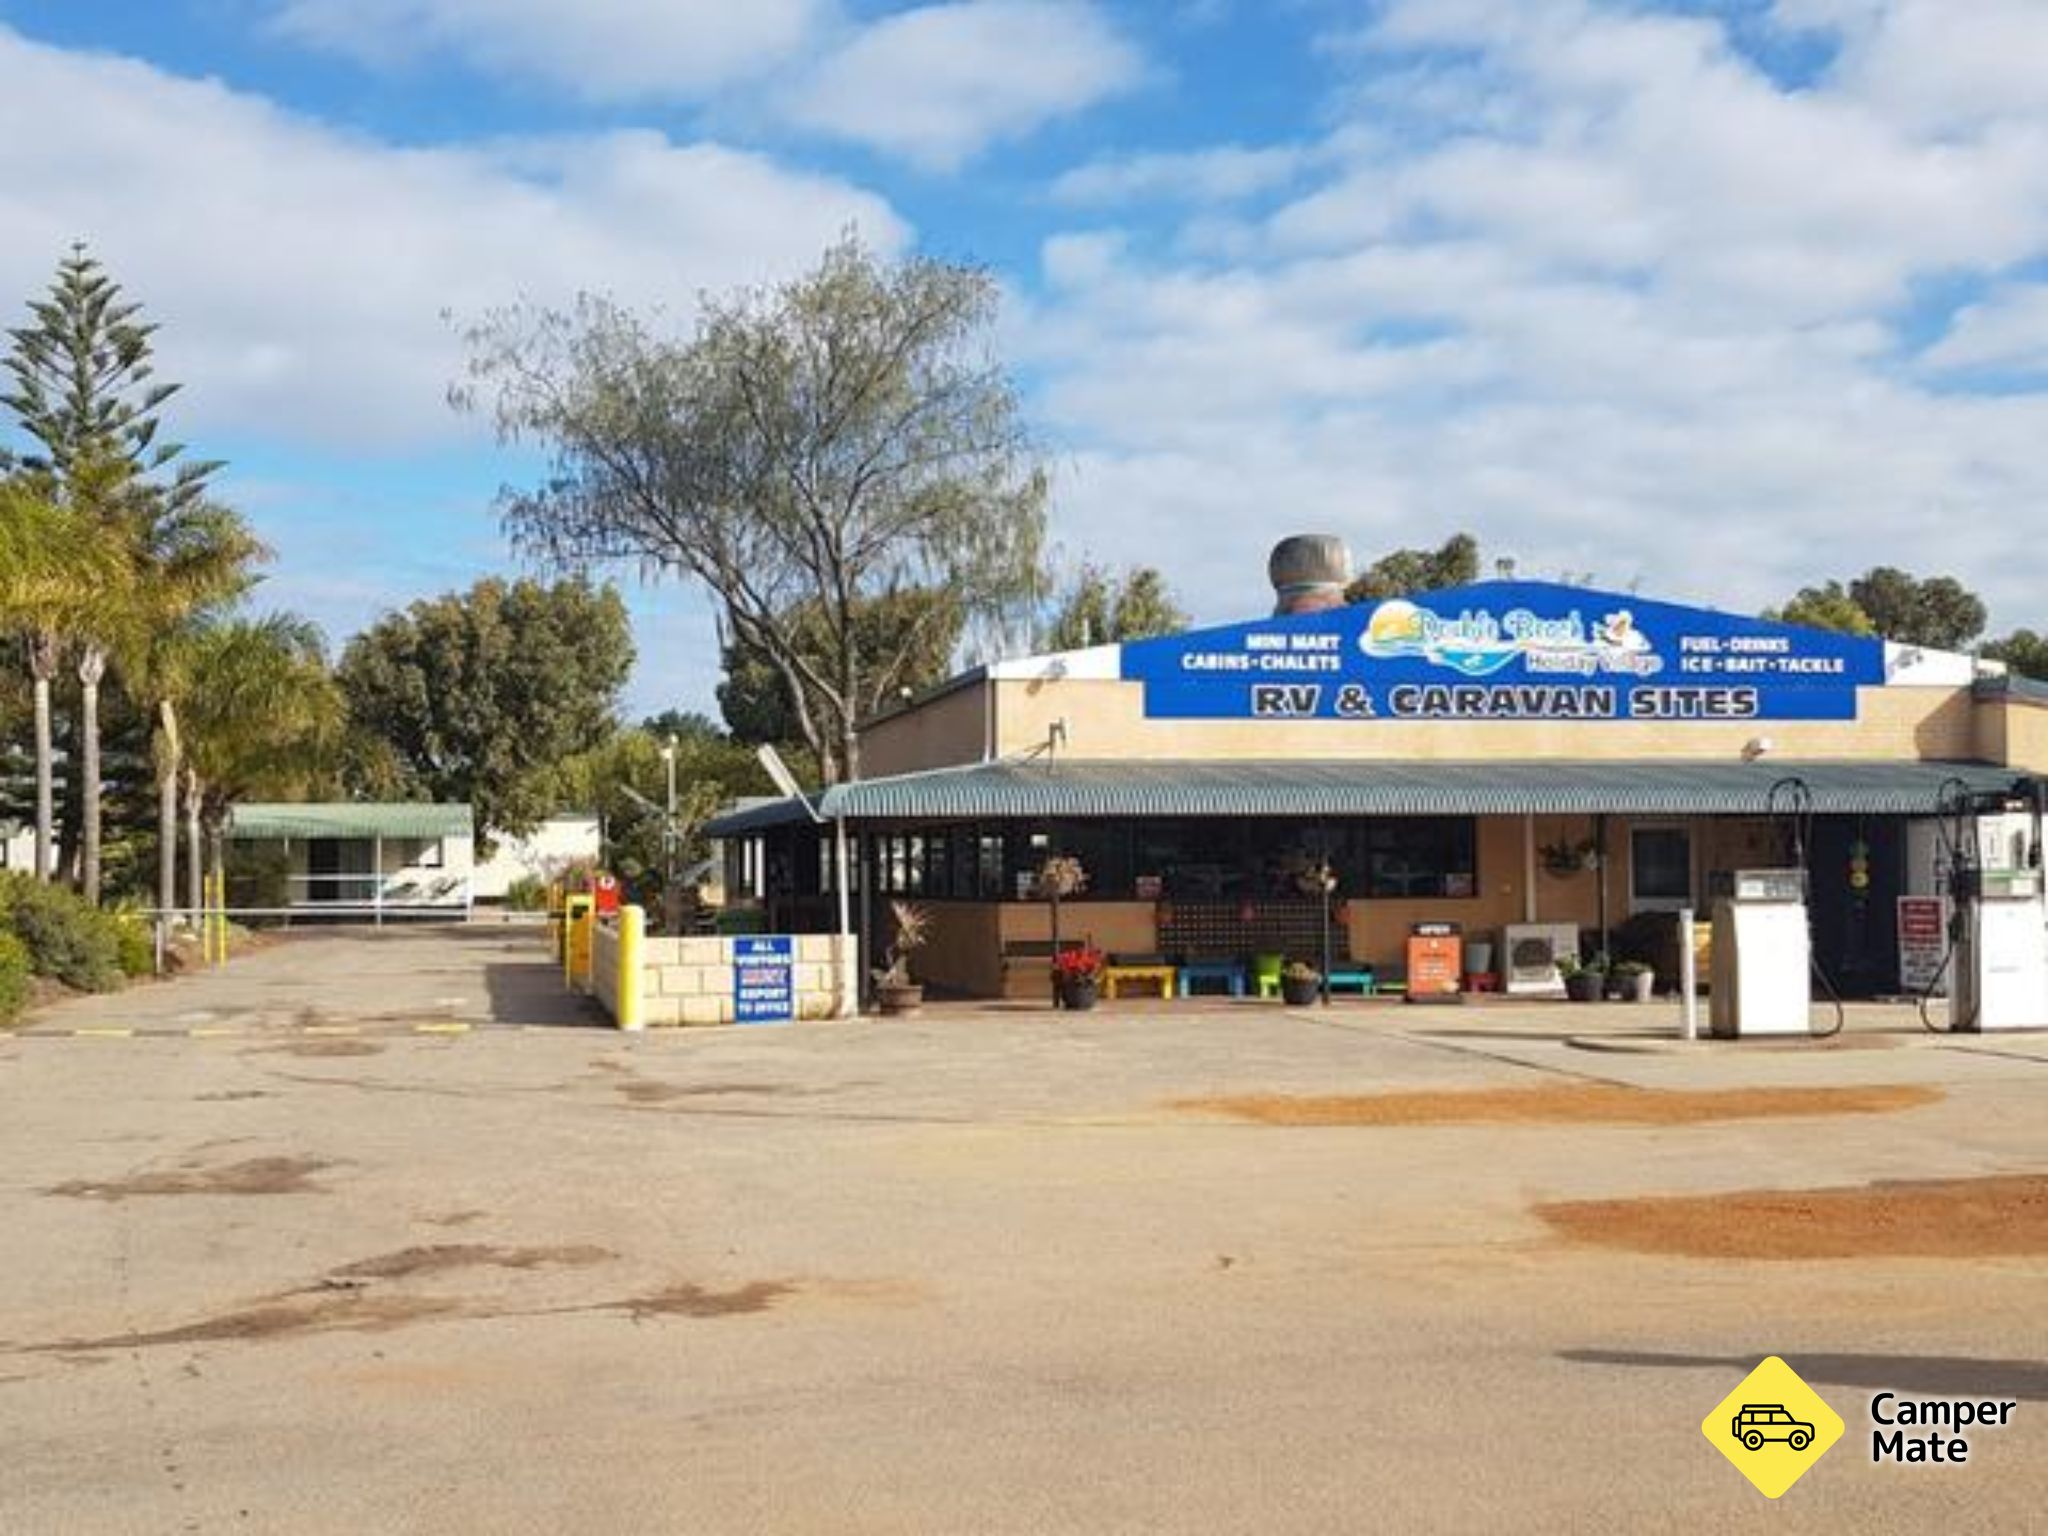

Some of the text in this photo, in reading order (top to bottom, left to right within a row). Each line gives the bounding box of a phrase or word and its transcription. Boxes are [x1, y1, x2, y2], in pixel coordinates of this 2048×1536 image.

[1291, 635, 1341, 650] MART
[1253, 684, 1758, 717] RV & CARAVAN SITES
[751, 940, 776, 952] ALL
